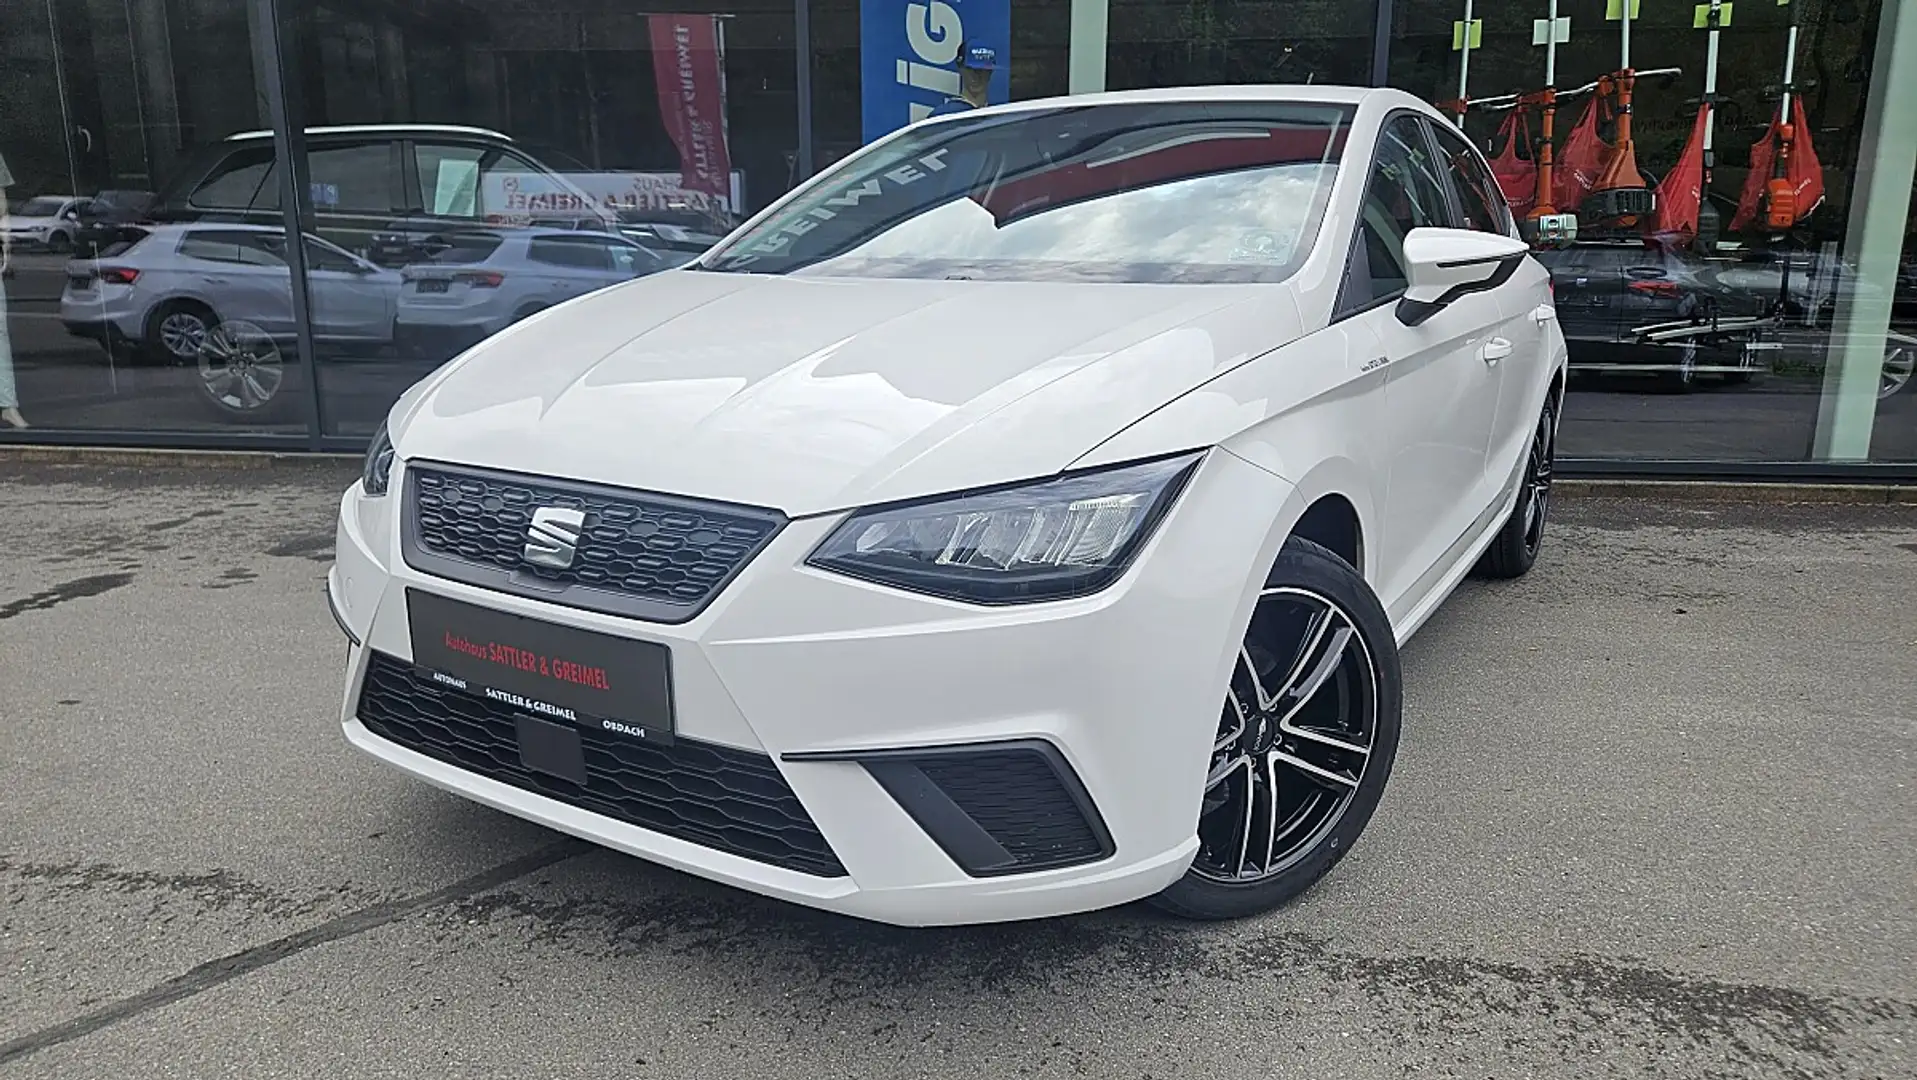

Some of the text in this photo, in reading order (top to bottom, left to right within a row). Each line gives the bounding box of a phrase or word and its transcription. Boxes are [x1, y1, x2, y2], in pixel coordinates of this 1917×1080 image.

[444, 631, 611, 691] Autohaus SATTLER & GREIMEL
[485, 687, 525, 706] SATTLER
[533, 701, 577, 721] GREIMEL
[602, 720, 646, 738] OBDACH
